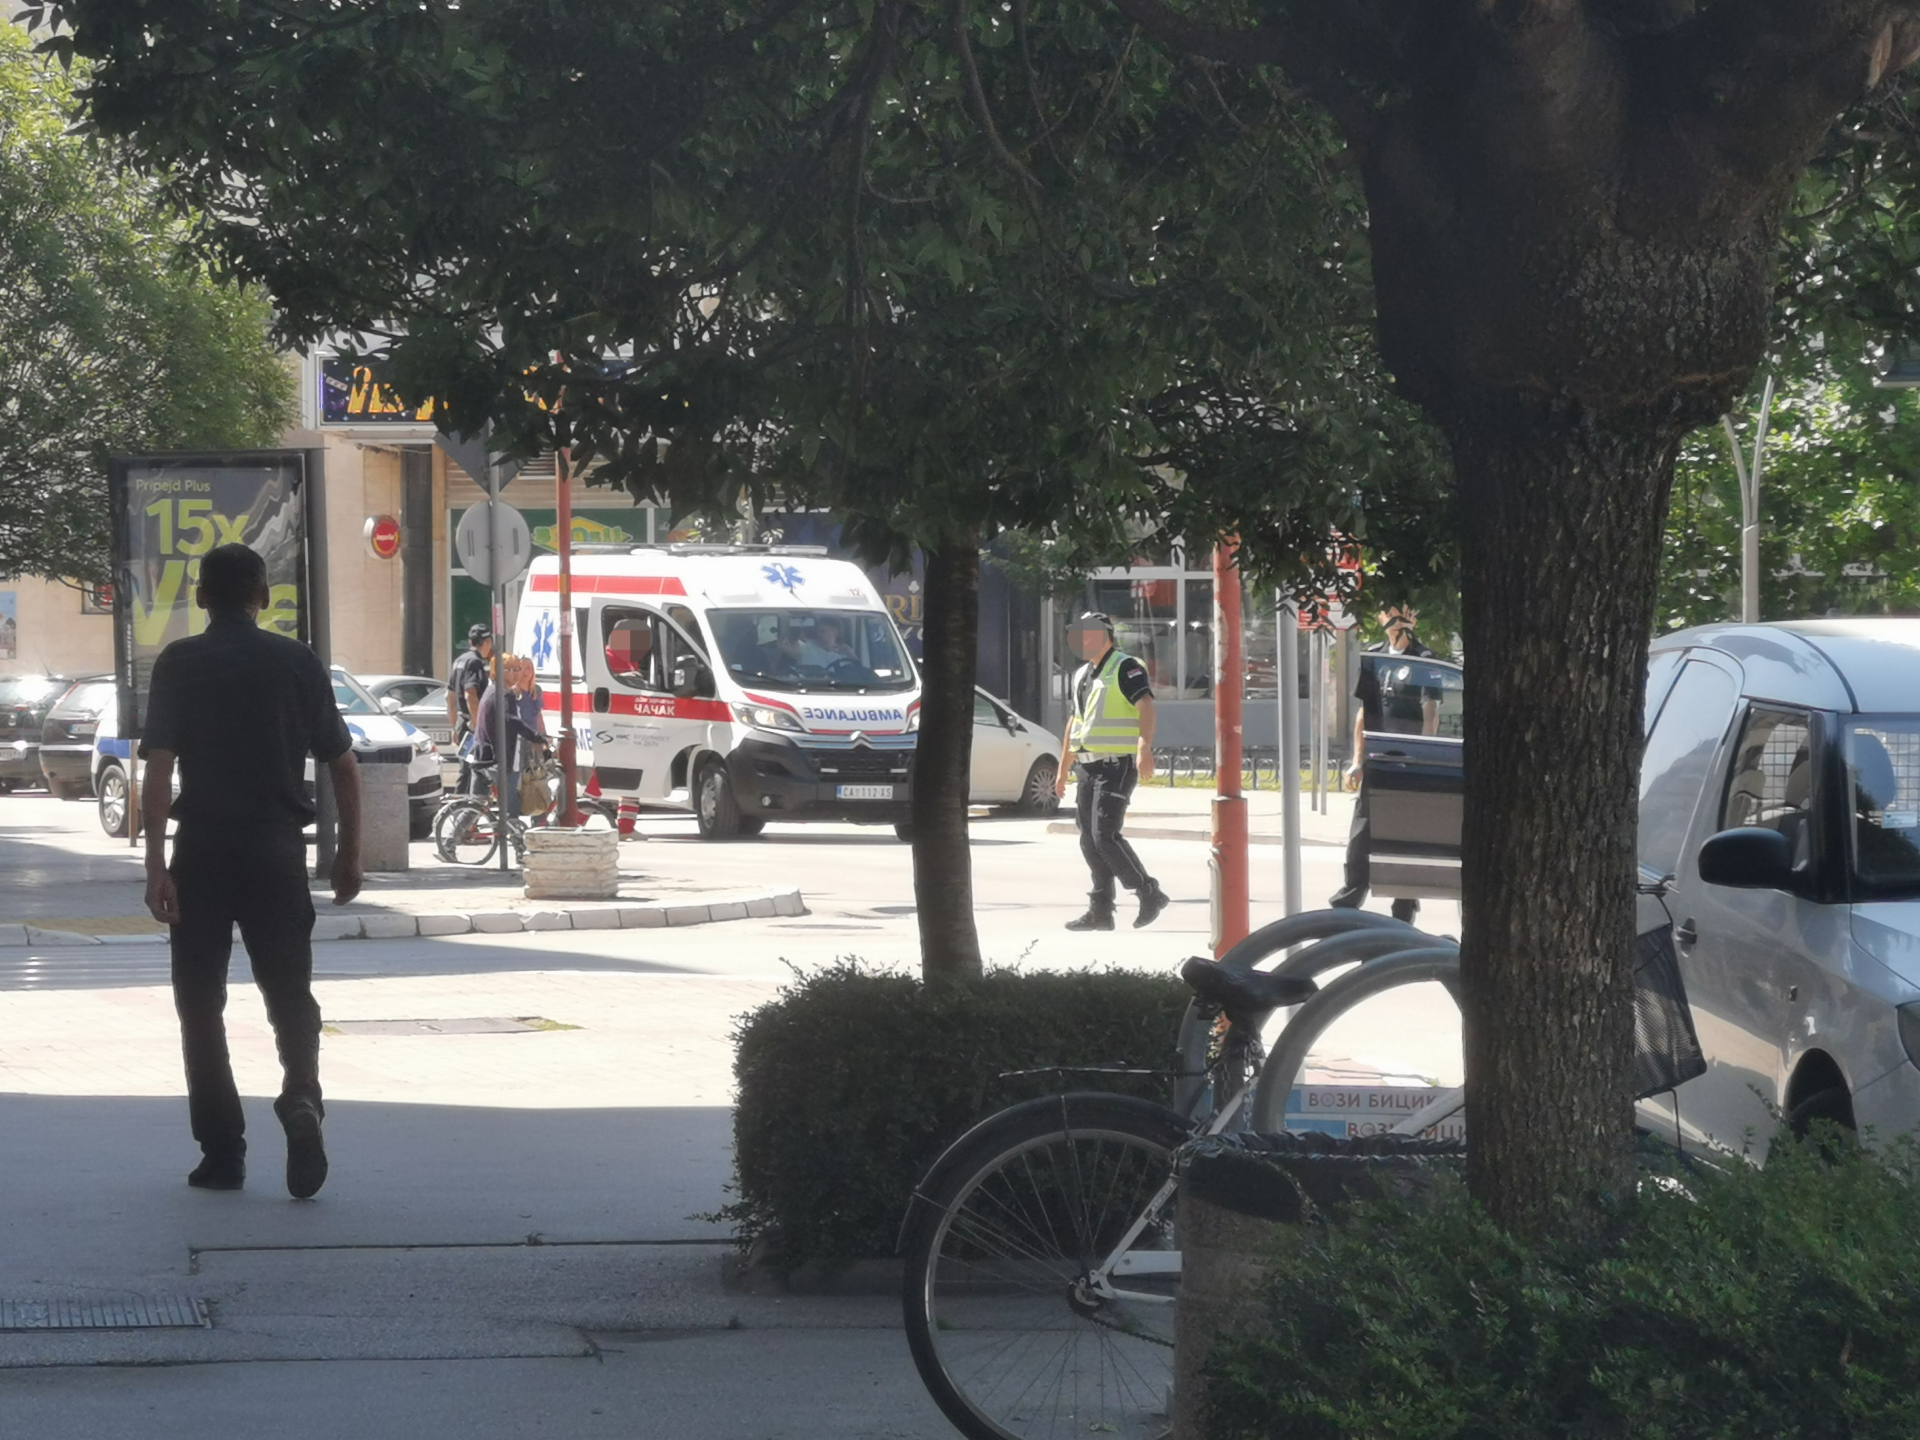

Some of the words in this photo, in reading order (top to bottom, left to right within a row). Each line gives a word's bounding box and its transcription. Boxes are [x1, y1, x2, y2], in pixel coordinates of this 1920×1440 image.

[135, 479, 182, 493] Pripejd
[184, 479, 211, 492] Plus
[145, 498, 250, 555] 15x
[132, 558, 298, 646] Vie
[634, 703, 675, 716] ЧАЧАК
[1308, 1092, 1361, 1108] ВОЗИ
